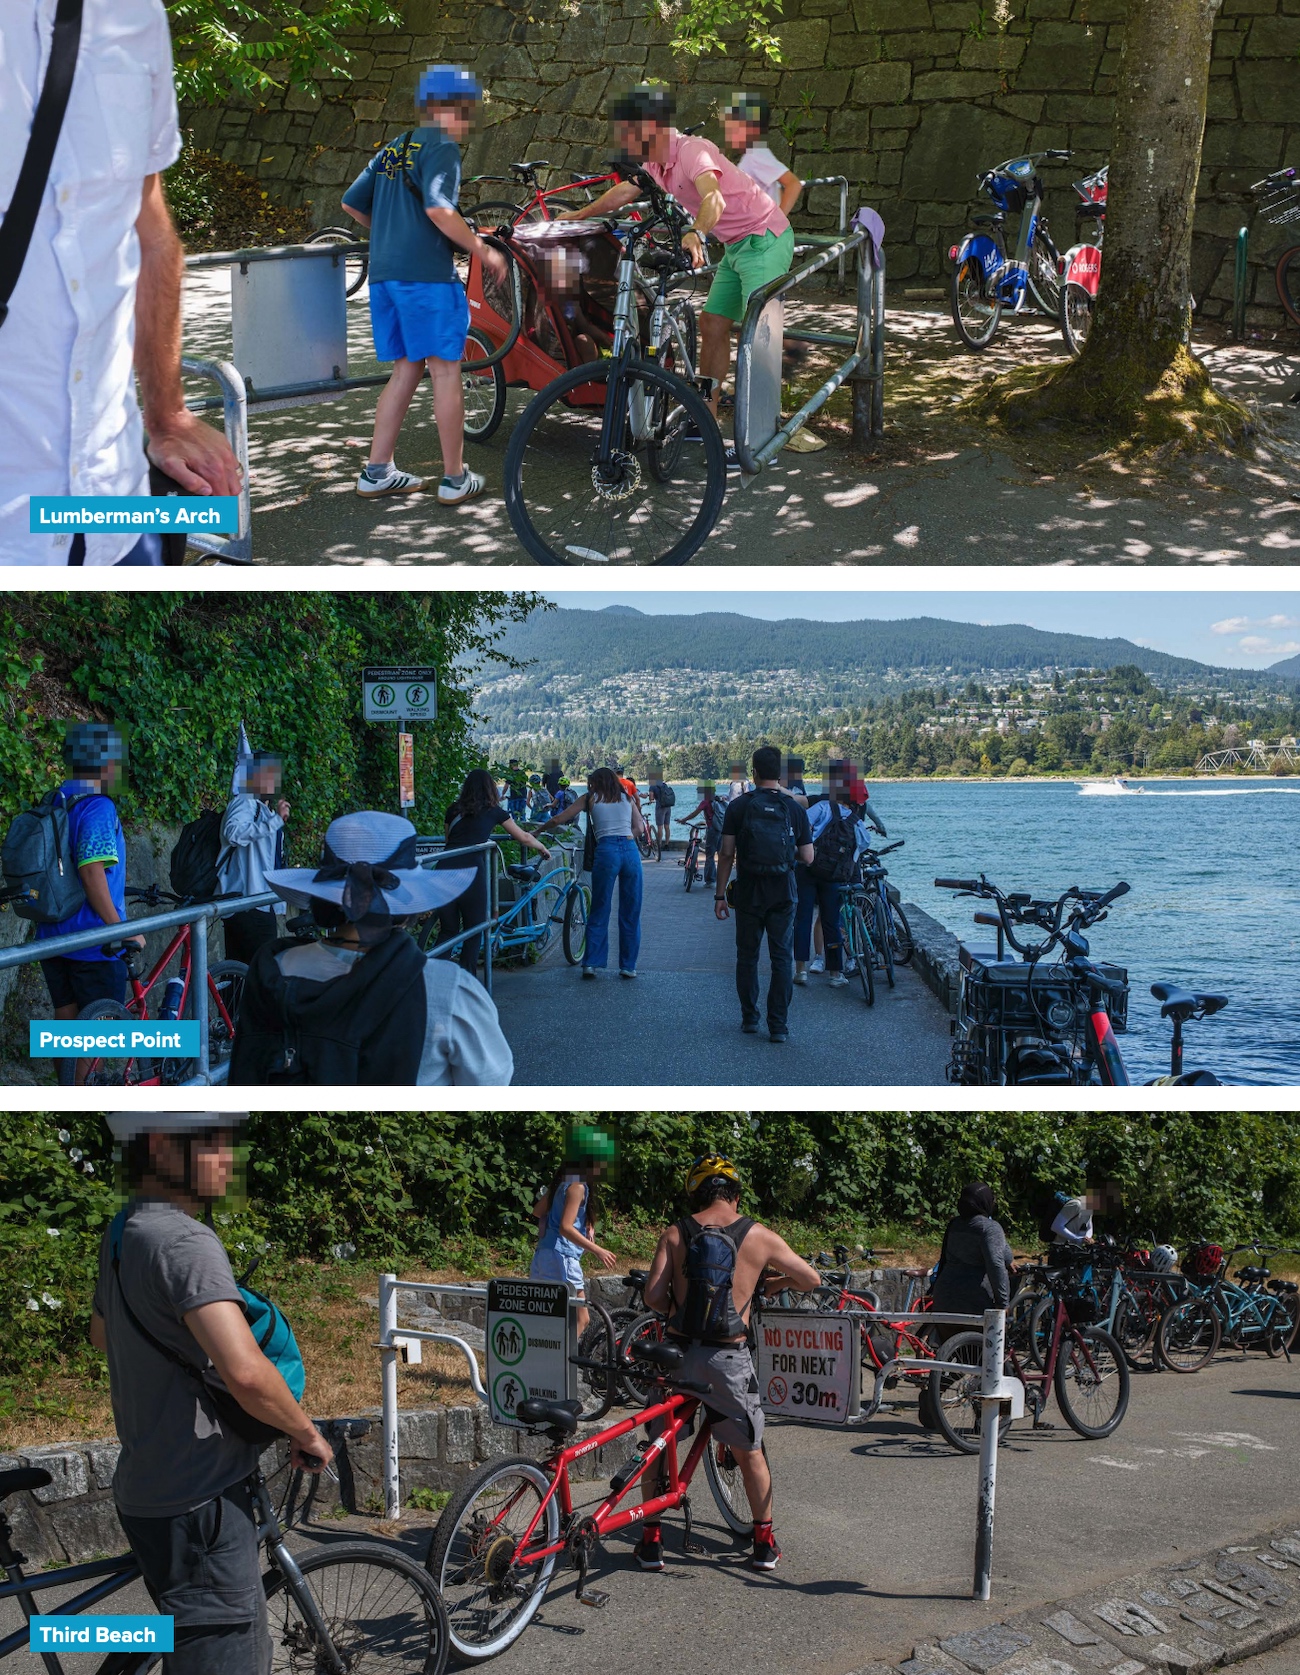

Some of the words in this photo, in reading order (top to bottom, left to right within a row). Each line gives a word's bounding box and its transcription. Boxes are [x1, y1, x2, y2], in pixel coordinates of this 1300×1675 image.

[1078, 263, 1098, 273] ROGERS
[496, 1284, 558, 1299] PEDESTRIAN
[499, 1299, 525, 1312] ZONE
[528, 1301, 554, 1313] ONLY
[527, 1337, 561, 1351] DISMOUNT
[764, 1328, 782, 1348] NO
[785, 1329, 843, 1351] CYCLING
[772, 1353, 797, 1373] FOR
[801, 1355, 836, 1376] NEXT
[529, 1387, 557, 1400] WALKING
[791, 1381, 837, 1408] 30m
